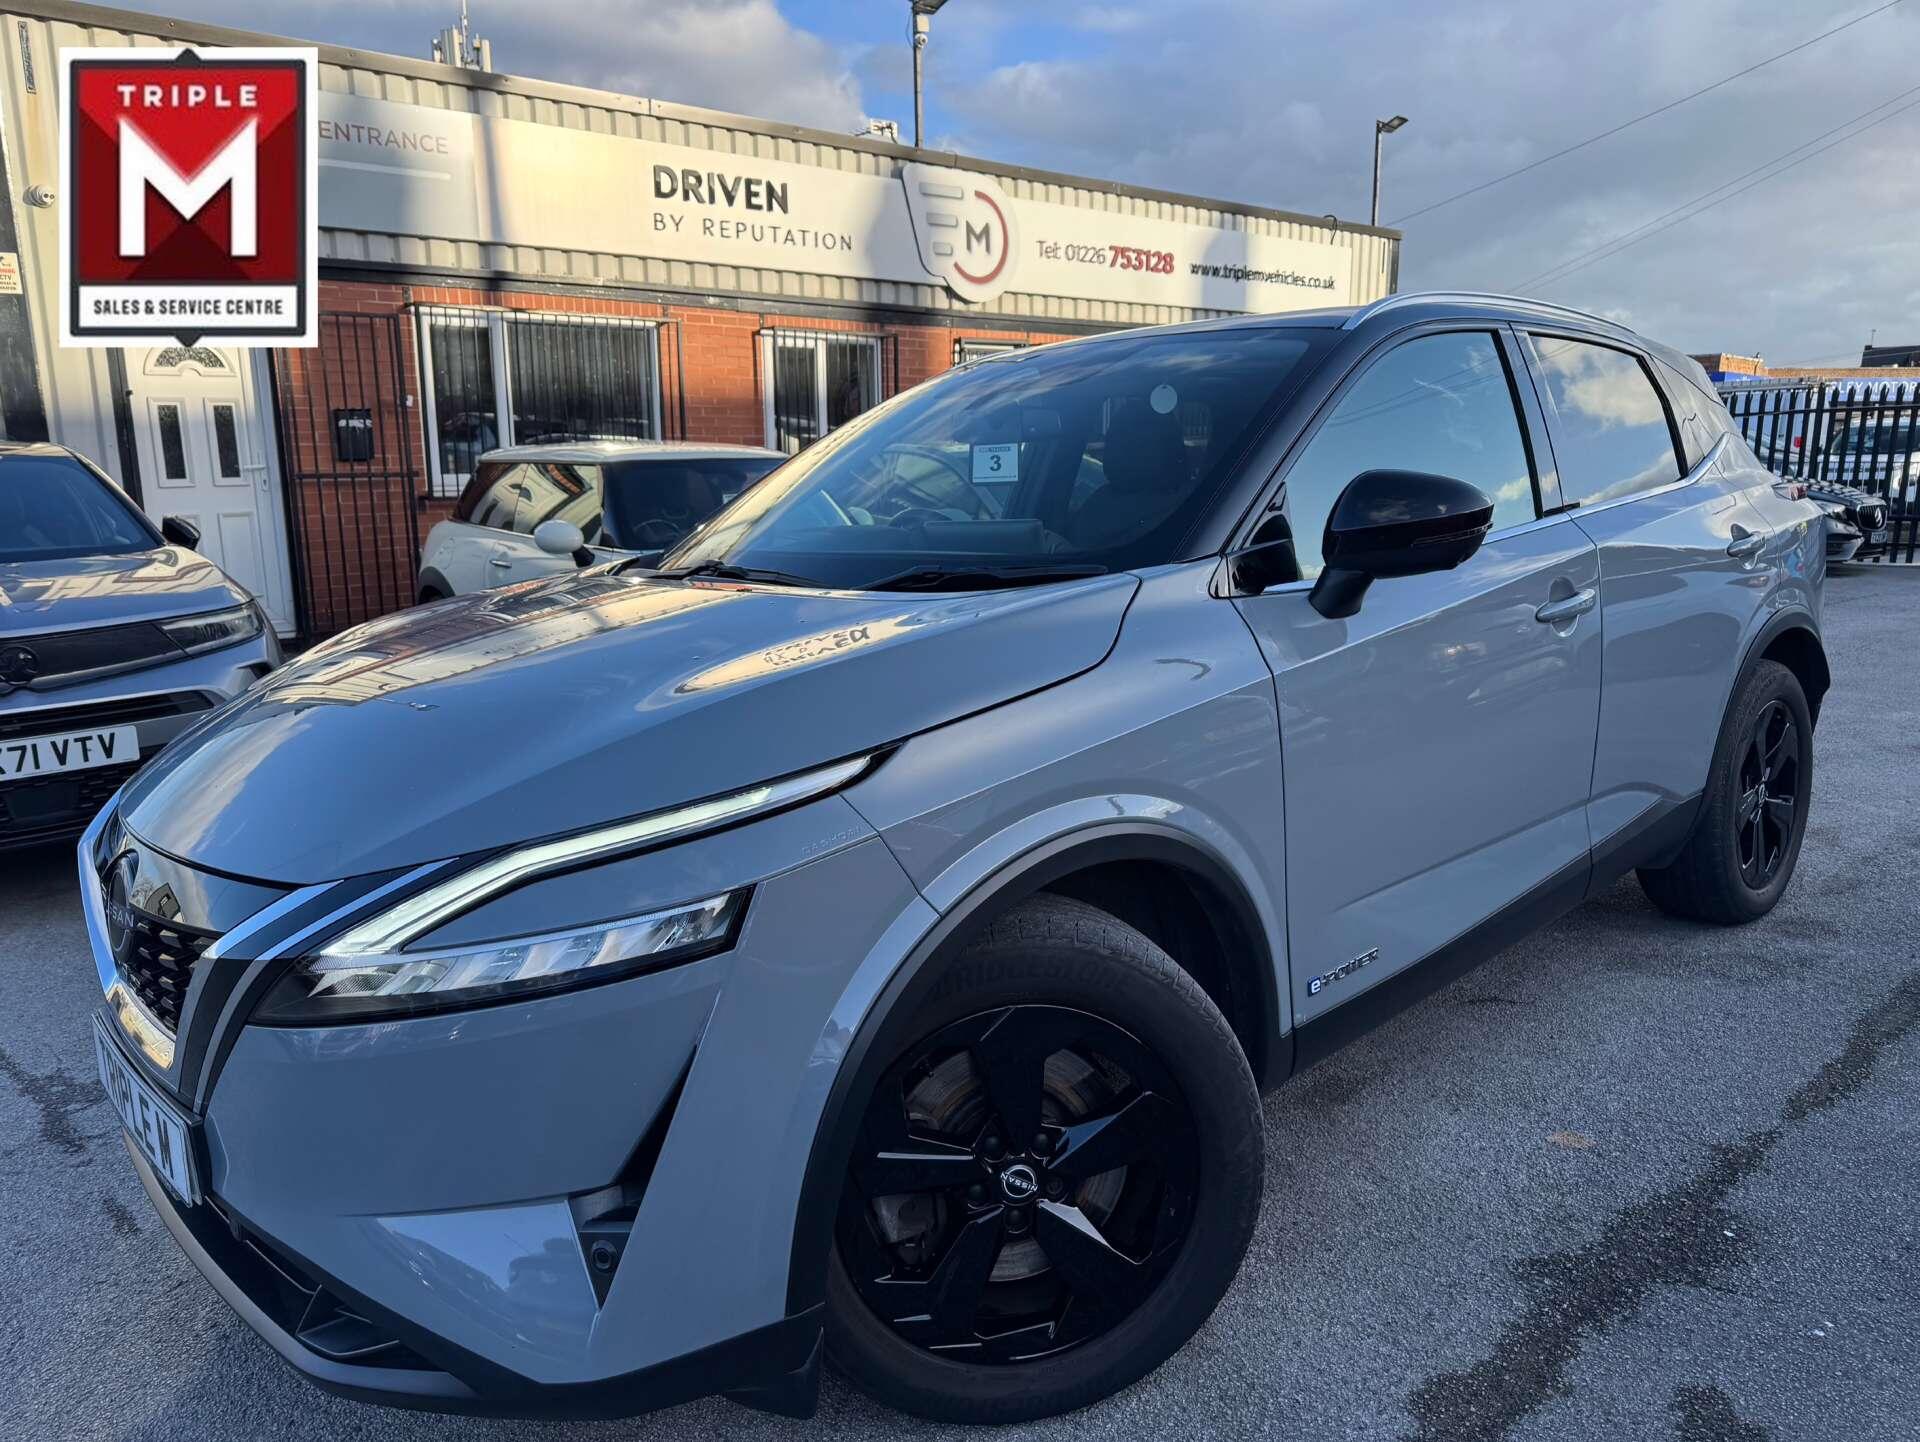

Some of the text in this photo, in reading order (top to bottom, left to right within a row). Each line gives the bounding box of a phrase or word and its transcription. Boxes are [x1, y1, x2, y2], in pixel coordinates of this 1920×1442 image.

[318, 119, 449, 154] ENTRANCE
[653, 164, 789, 215] DRIVEN
[653, 212, 852, 251] BY REPUTATION
[964, 220, 992, 255] M
[1064, 243, 1106, 265] 01226
[1108, 244, 1175, 275] 753128
[1190, 262, 1336, 290] www.triplemvehicles.co.uk
[990, 455, 1001, 471] 3
[50, 732, 115, 766] VTV
